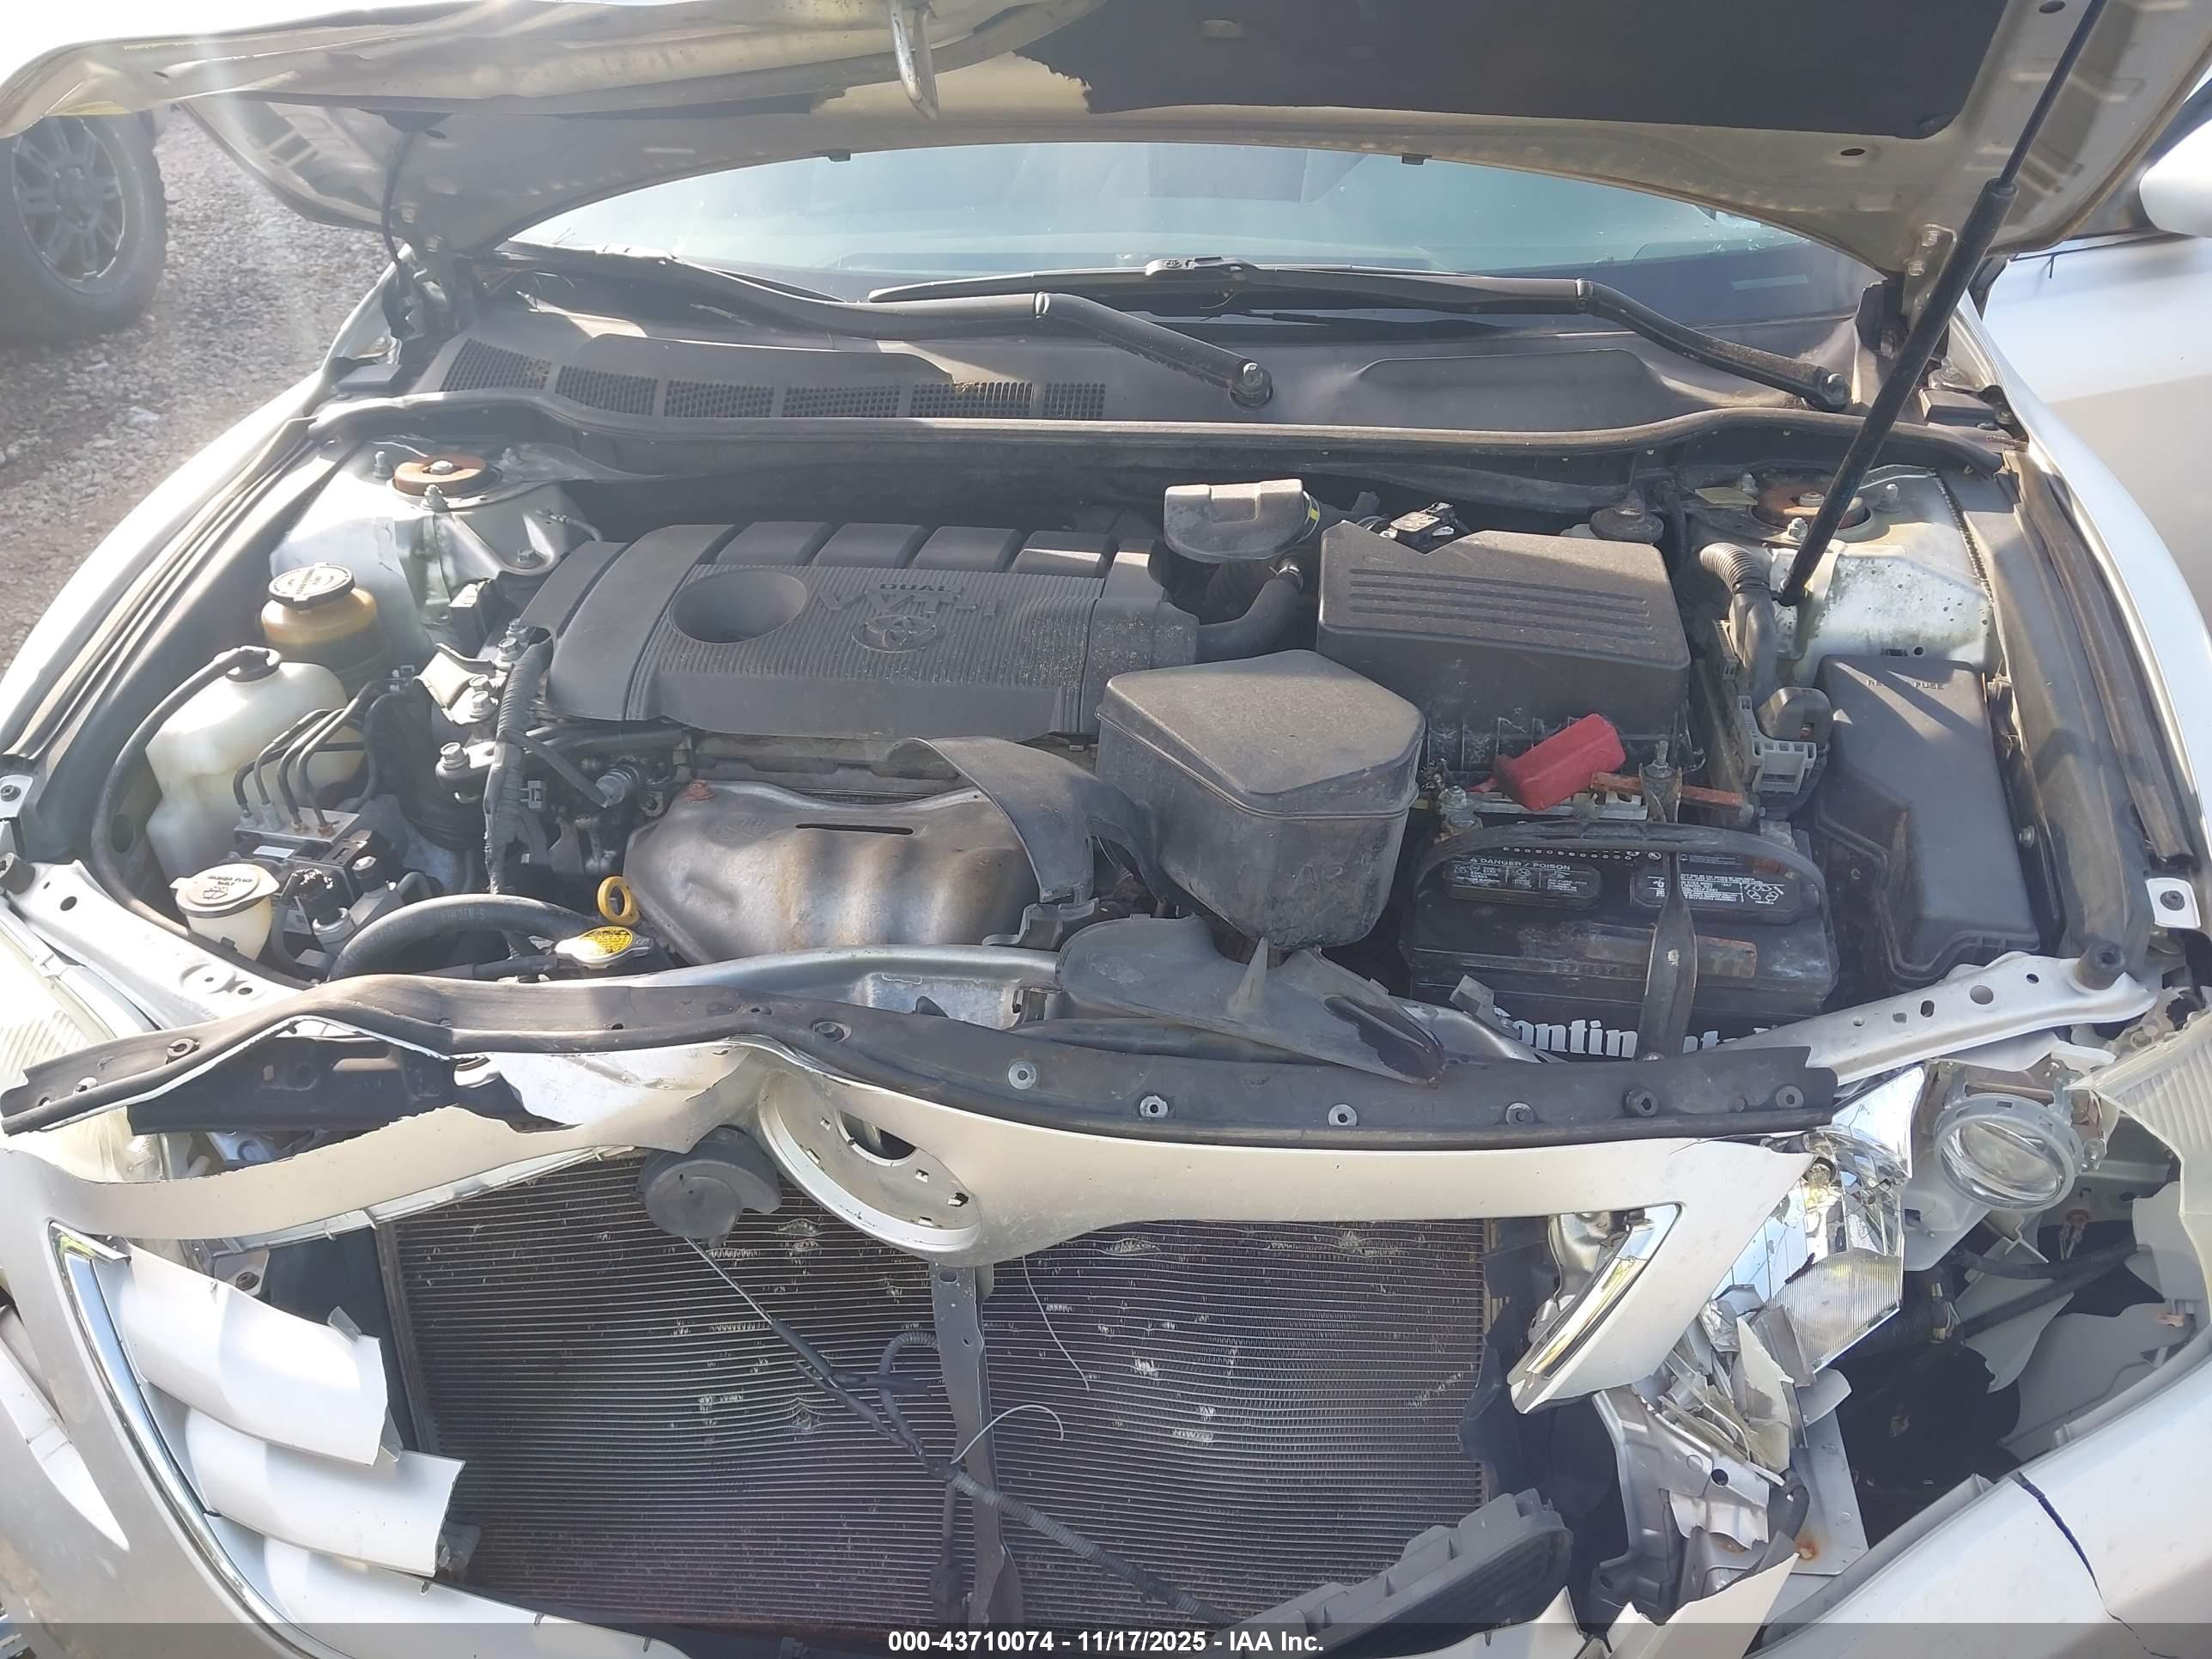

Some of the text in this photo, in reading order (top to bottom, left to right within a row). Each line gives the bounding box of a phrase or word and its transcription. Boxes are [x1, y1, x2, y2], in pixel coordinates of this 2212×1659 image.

[878, 583, 951, 592] DUAL
[1914, 681, 1945, 690] FUSE
[1480, 857, 1522, 867] DANGER
[1532, 862, 1571, 871] POISON
